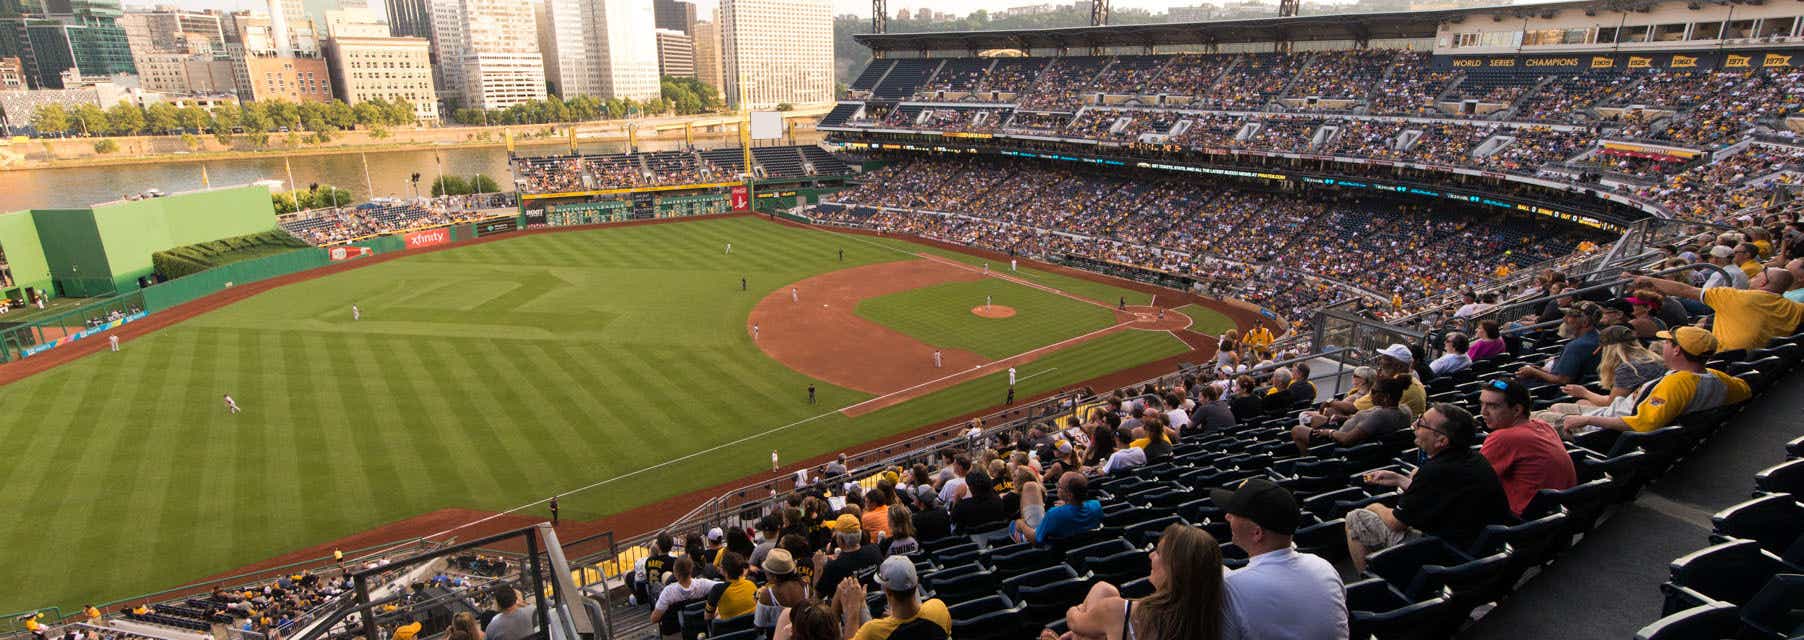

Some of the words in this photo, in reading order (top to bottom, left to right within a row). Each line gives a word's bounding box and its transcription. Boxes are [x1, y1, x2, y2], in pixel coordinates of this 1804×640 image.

[1452, 59, 1482, 67] WORLD
[1488, 58, 1515, 67] SERIES
[1525, 57, 1579, 67] CHAMPIONS
[556, 205, 594, 213] NATIONAL
[411, 232, 444, 246] xfinity
